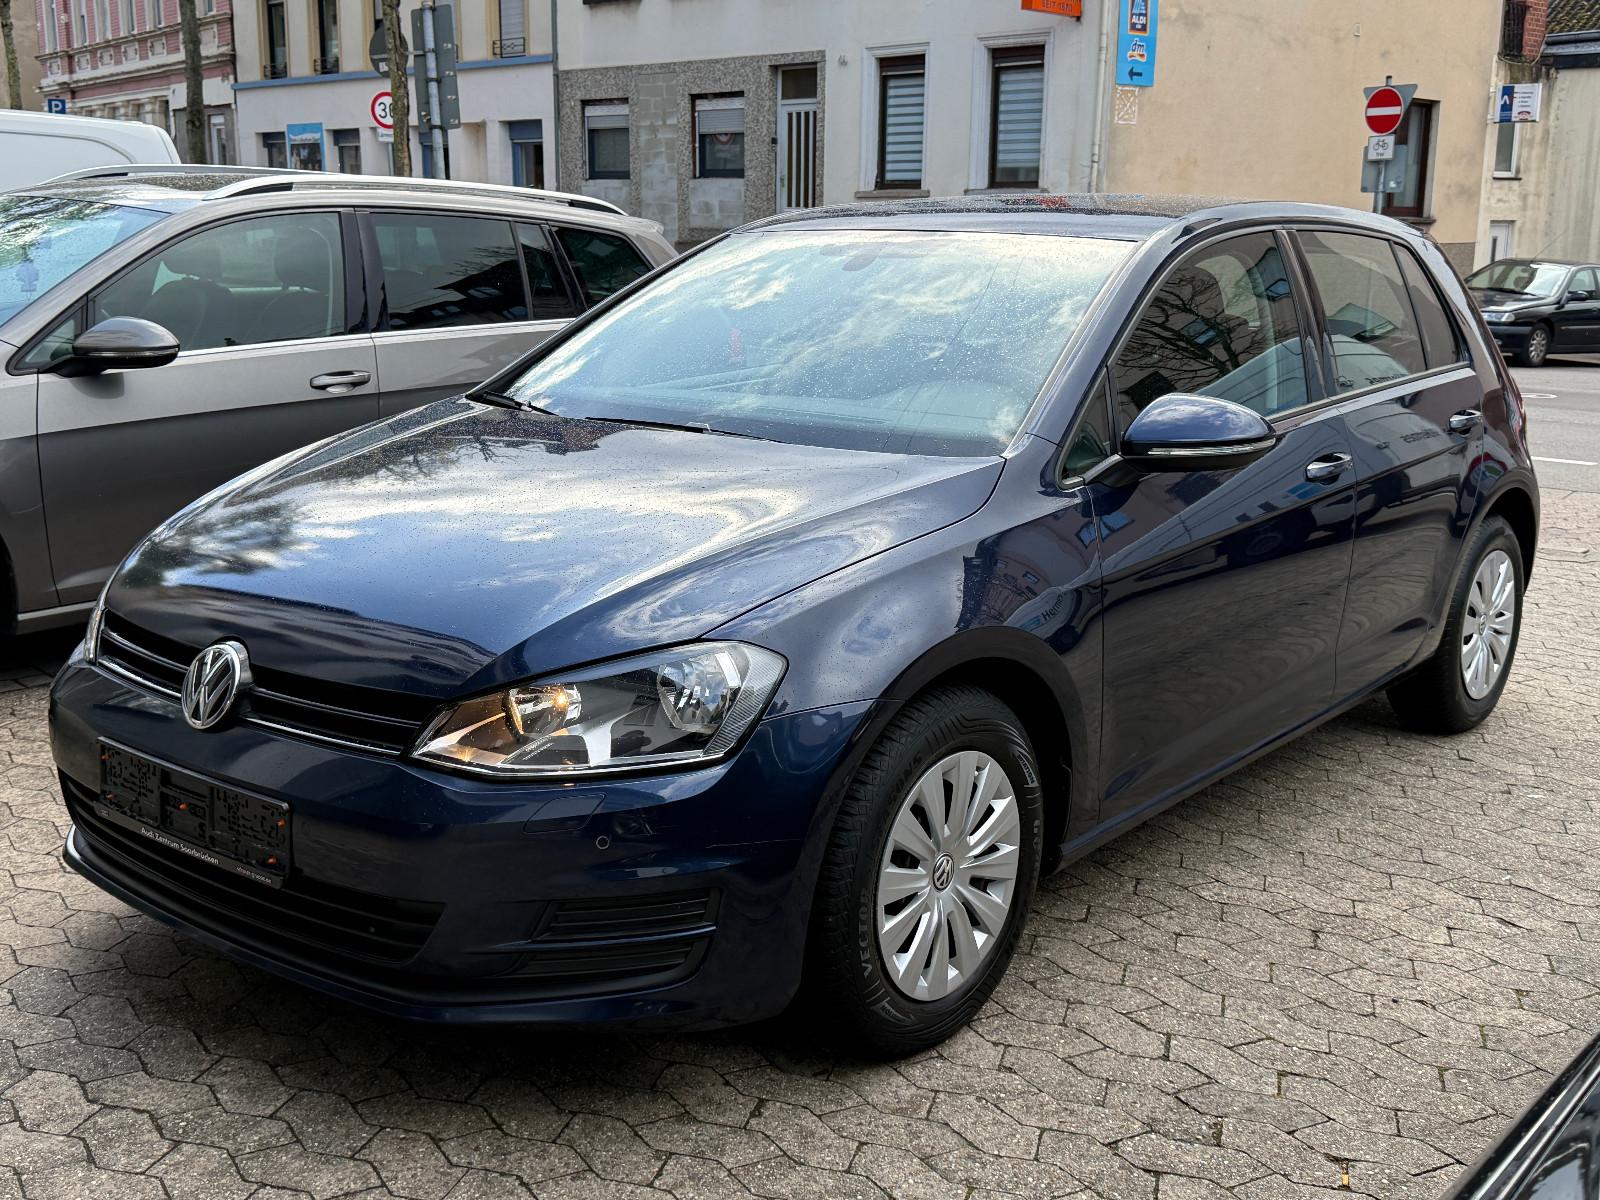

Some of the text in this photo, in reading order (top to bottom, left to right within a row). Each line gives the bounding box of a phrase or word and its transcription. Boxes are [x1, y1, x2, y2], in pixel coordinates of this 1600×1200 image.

[1131, 15, 1147, 24] ALDI
[1131, 39, 1145, 53] dm
[52, 101, 62, 113] P
[140, 826, 219, 865] Audi Zentrum Saarbrücken
[858, 887, 873, 978] VECTOR
